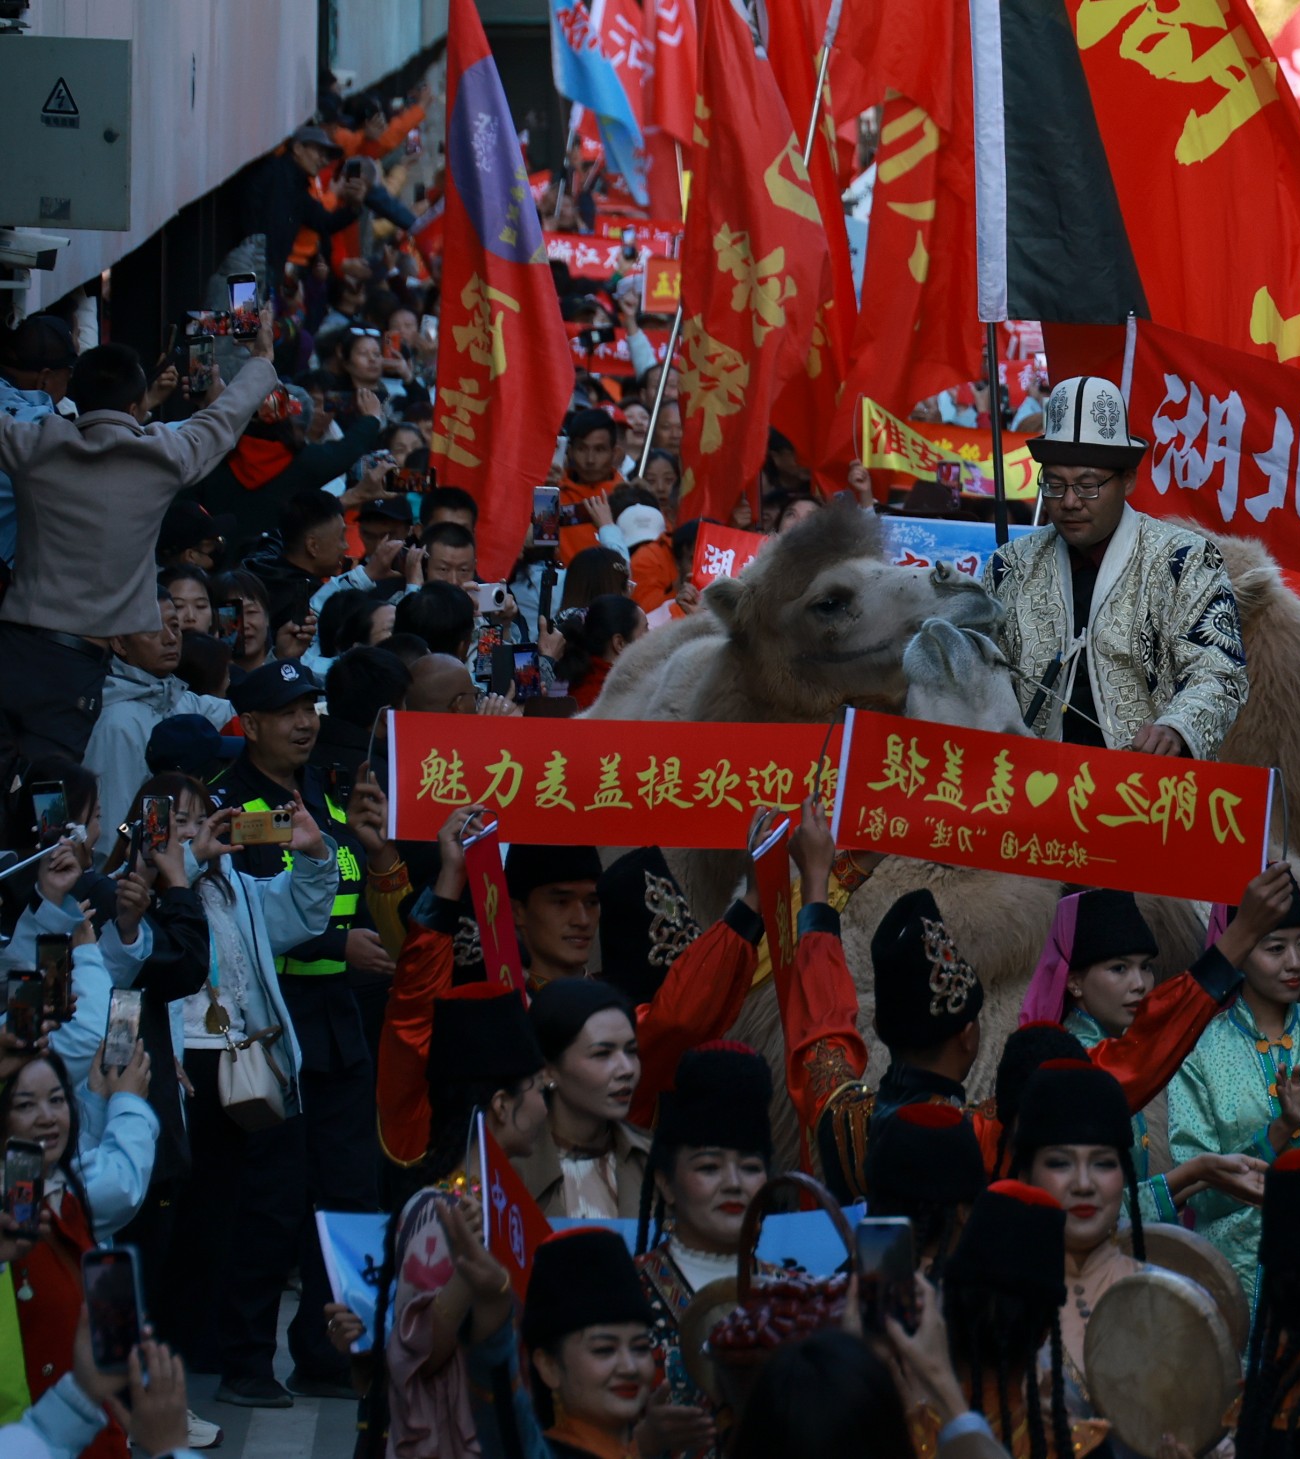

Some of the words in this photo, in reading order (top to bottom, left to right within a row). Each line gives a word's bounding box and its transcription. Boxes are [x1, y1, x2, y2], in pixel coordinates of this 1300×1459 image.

[701, 544, 758, 577] 湖
[416, 748, 840, 817] 魅力麦盖提欢迎您
